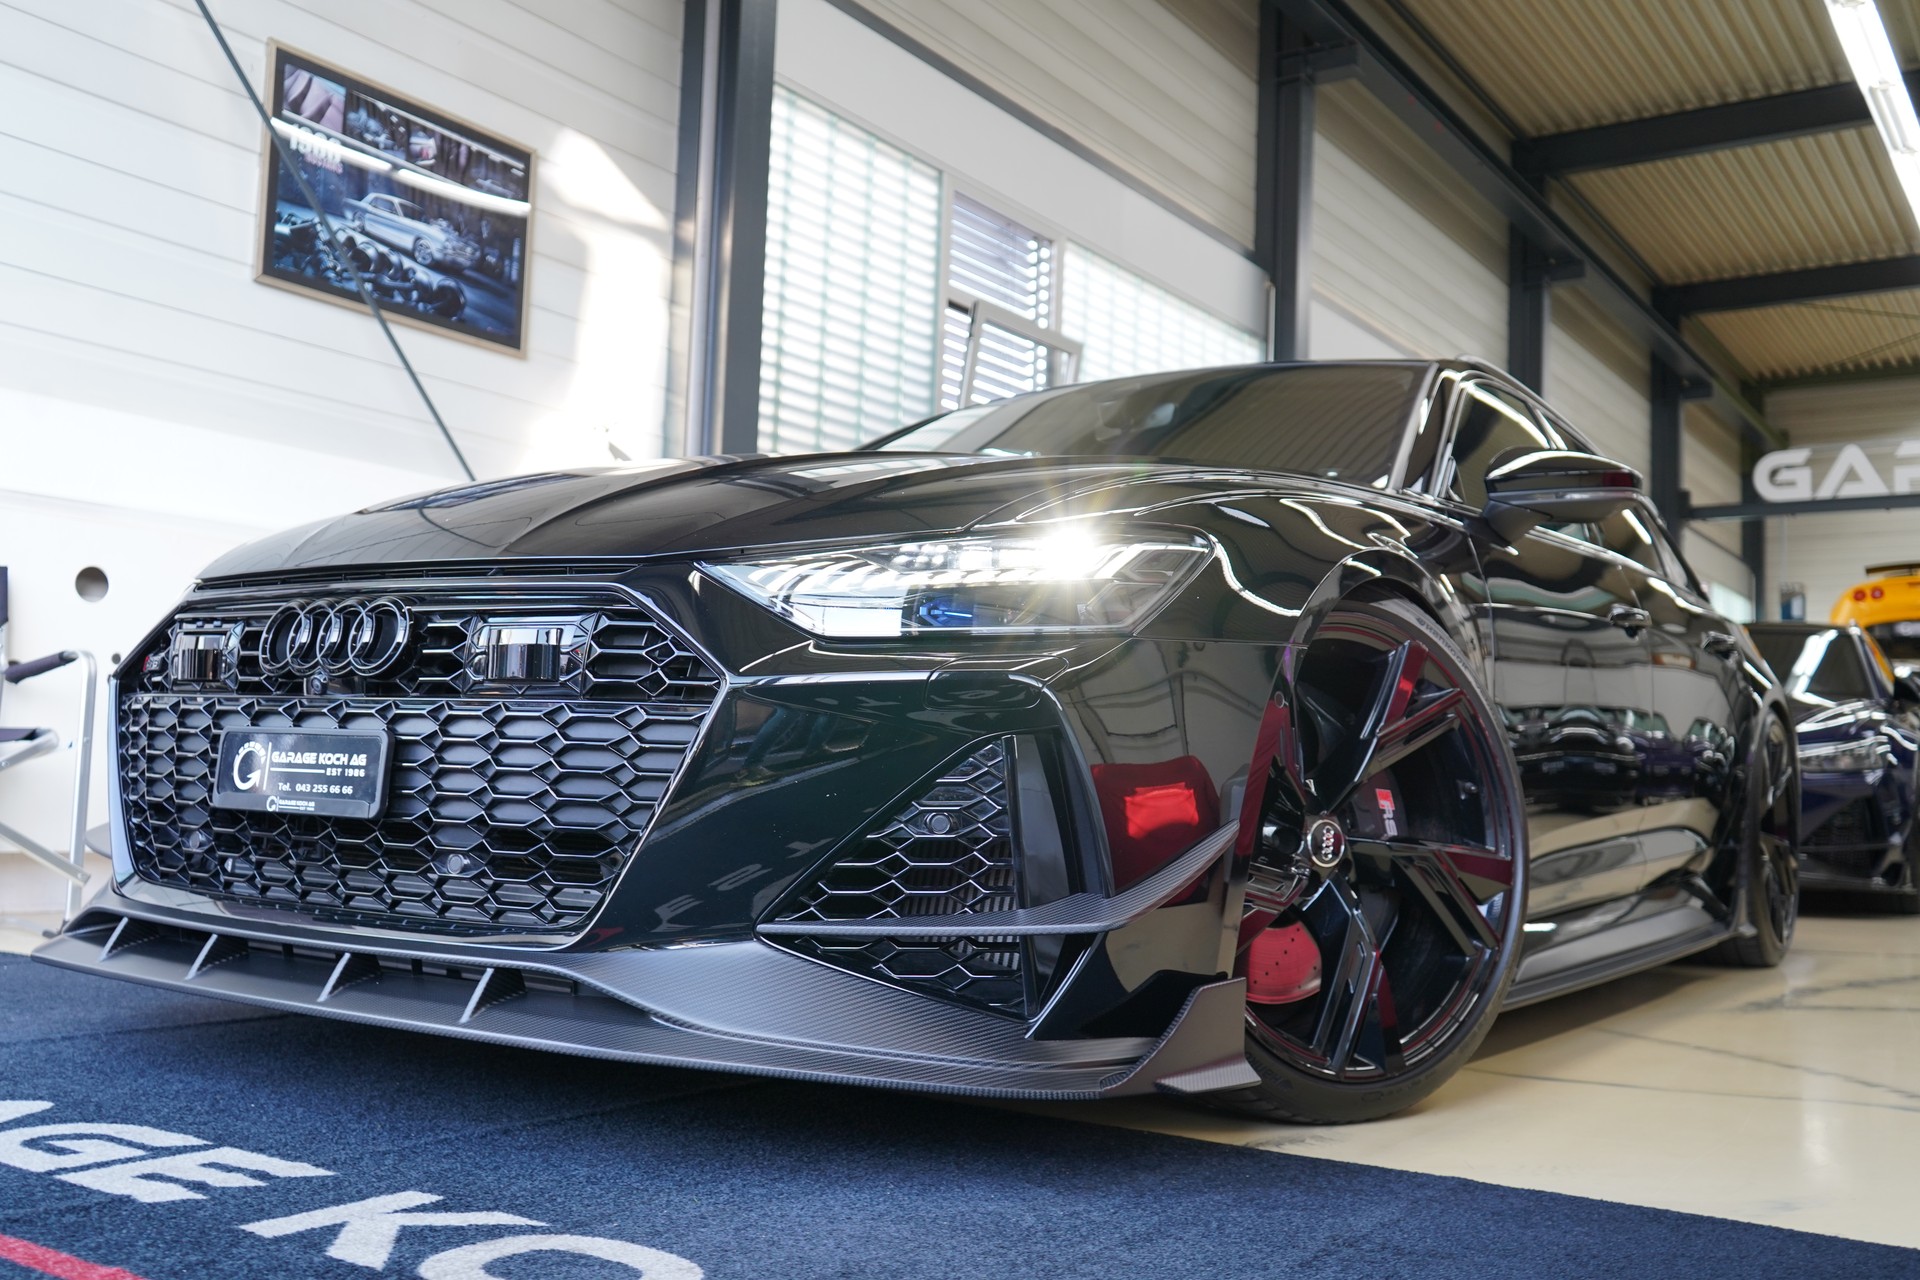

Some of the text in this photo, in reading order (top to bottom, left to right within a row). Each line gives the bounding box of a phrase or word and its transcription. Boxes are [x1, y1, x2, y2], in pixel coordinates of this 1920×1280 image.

[272, 751, 367, 766] GARAGE KOCH AG
[326, 768, 365, 777] EST 1986
[278, 782, 353, 794] Tel. 043 255 66 66
[1379, 800, 1398, 837] RS
[0, 1100, 338, 1203] GE
